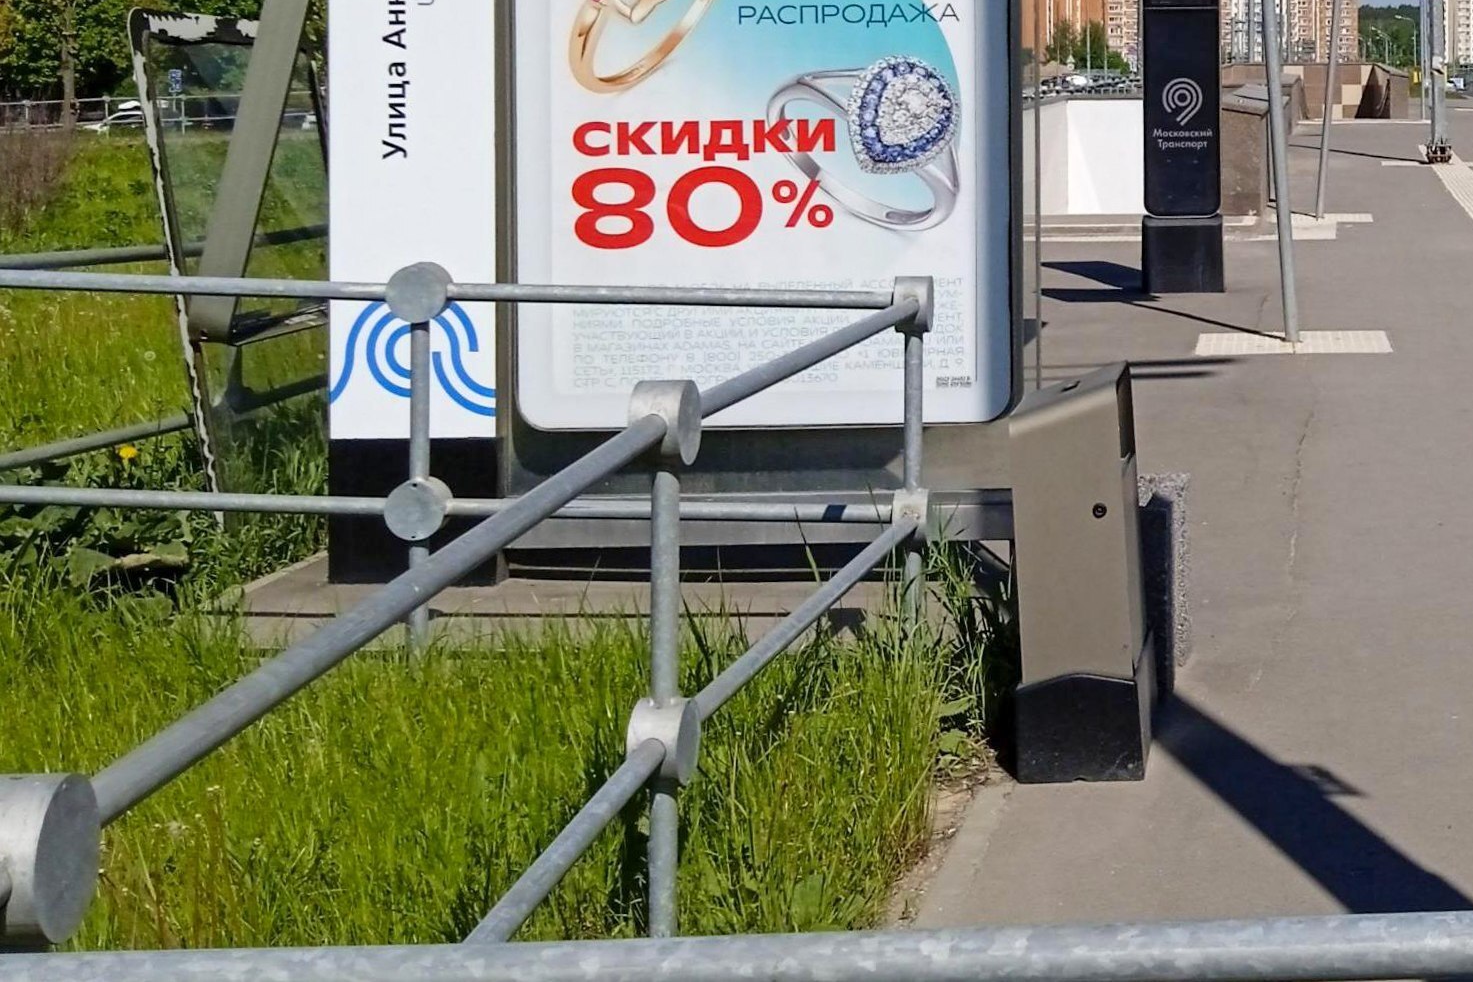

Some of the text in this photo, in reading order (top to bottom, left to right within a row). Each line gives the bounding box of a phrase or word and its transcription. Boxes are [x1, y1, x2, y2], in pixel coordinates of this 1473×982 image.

[738, 2, 960, 28] РАСПРОДАЖА
[381, 61, 411, 160] Улица
[572, 118, 836, 162] СКИДКИ
[1152, 128, 1213, 138] Московский
[1157, 139, 1208, 150] Транспорт
[571, 165, 835, 250] 80%
